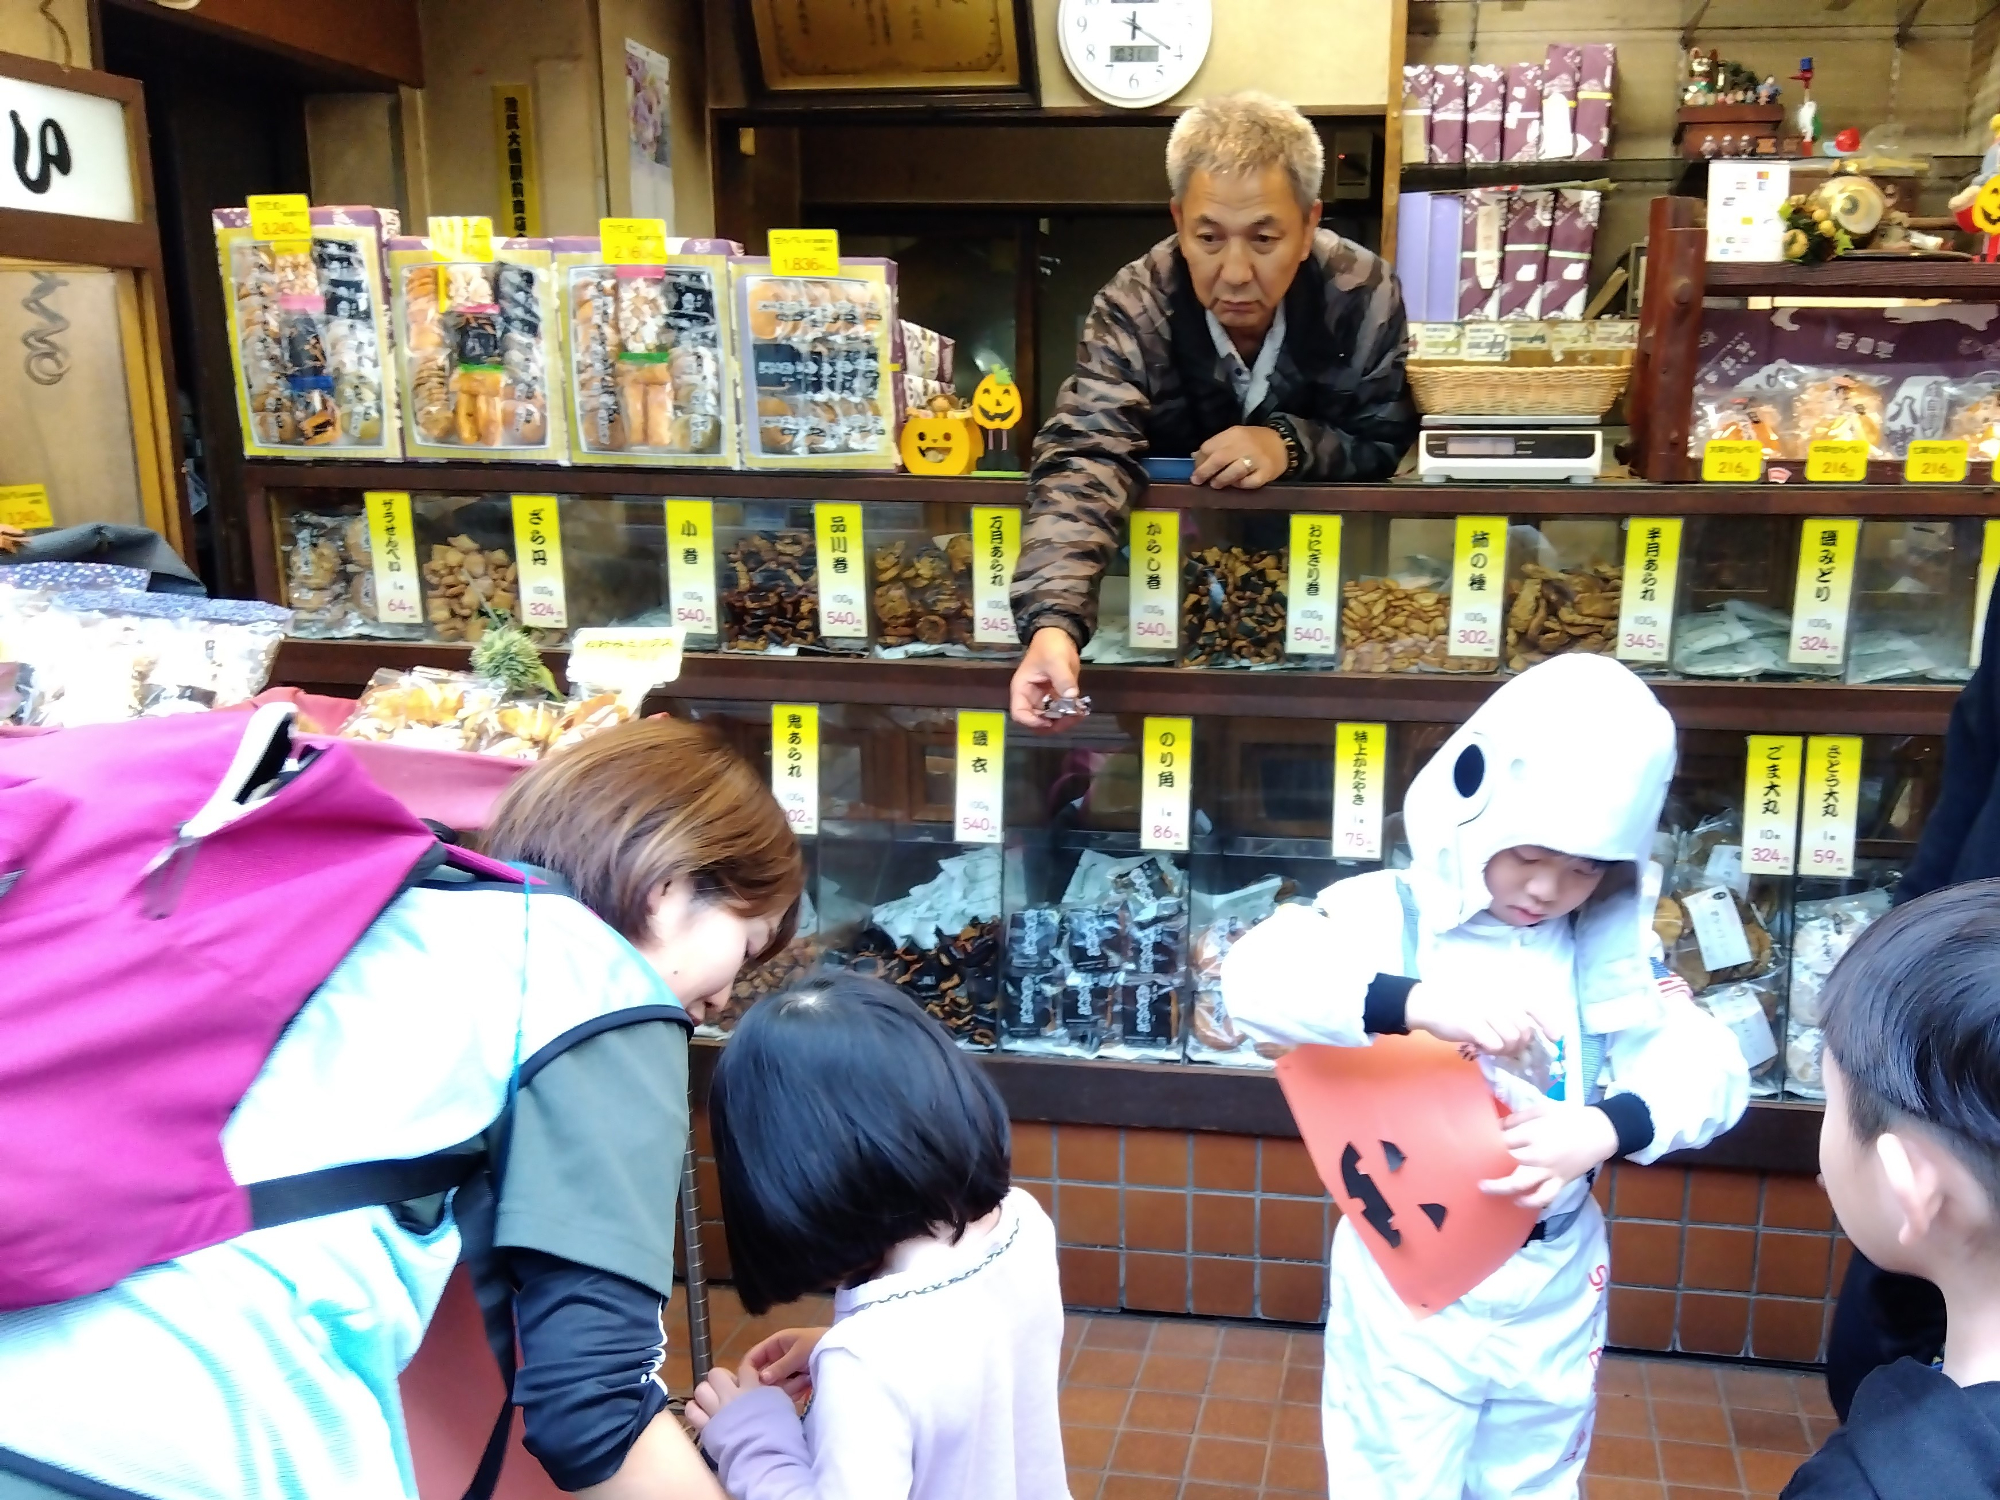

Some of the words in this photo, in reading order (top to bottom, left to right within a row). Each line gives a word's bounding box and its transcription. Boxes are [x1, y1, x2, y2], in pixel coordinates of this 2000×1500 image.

[681, 520, 699, 564] 小巻
[830, 515, 849, 573] 品川巻
[1145, 522, 1162, 589] からし巻
[1306, 524, 1322, 596] おにぎり巻
[787, 714, 803, 778] 鬼あられ
[1158, 732, 1176, 788] のり角
[1352, 730, 1369, 806] 特上かたやき
[1762, 744, 1785, 815] ごま大丸
